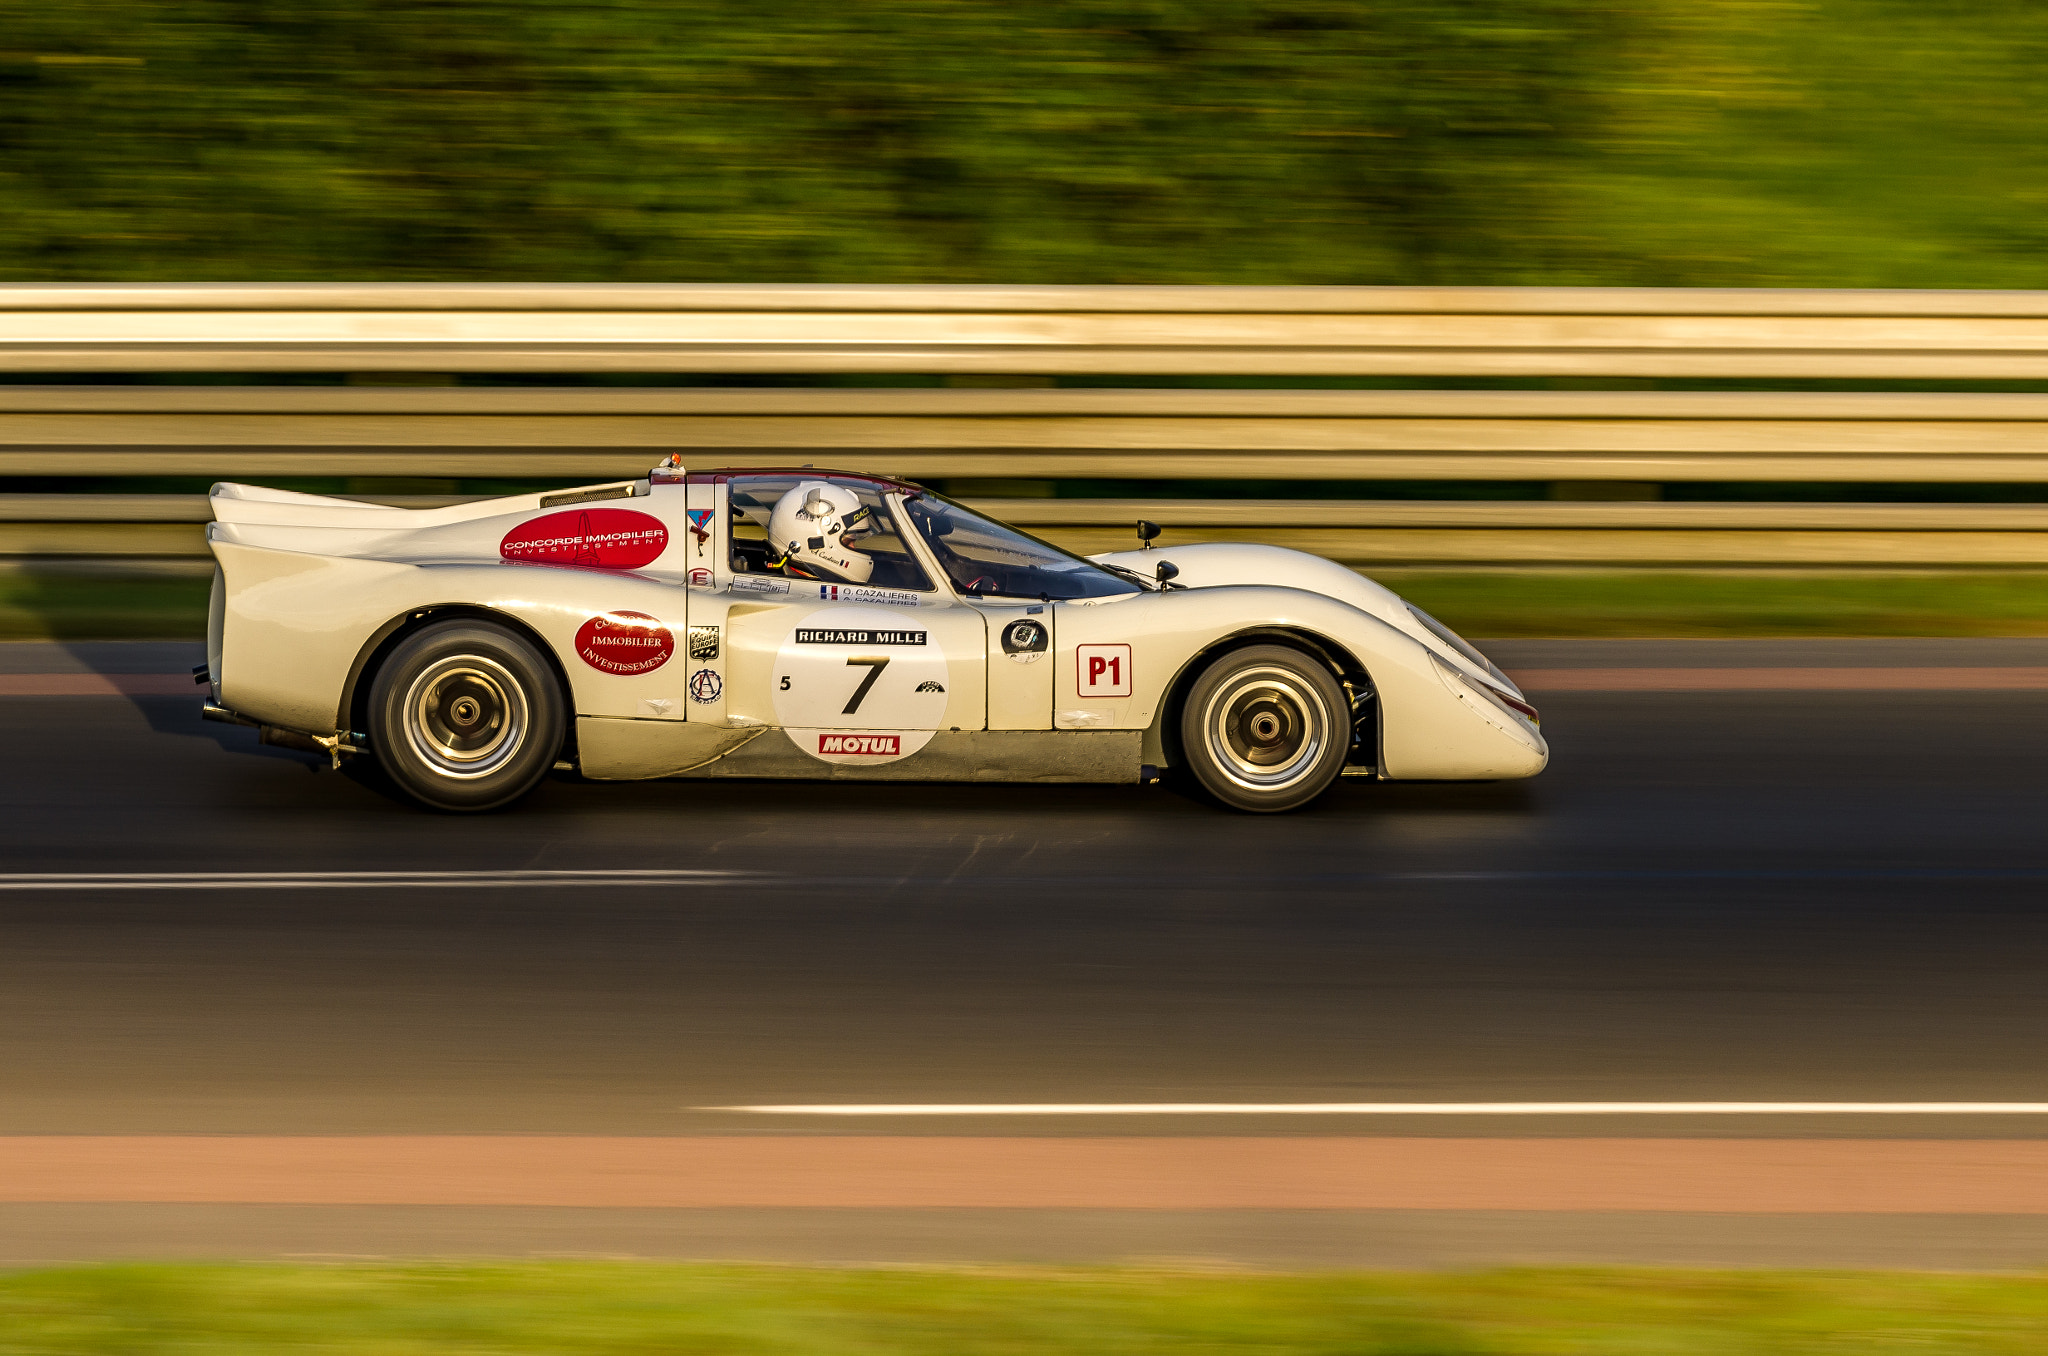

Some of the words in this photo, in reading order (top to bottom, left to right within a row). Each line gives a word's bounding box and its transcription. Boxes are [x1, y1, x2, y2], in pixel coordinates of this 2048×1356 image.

[504, 536, 583, 550] CONCORDE
[586, 529, 664, 543] IMMOBILIER
[505, 537, 664, 555] INVESTISSEMENT
[855, 589, 918, 600] CAZALIERES
[592, 636, 662, 647] IMMOBILIER
[691, 638, 718, 649] EUROPE
[799, 631, 868, 642] RICHARD
[876, 632, 924, 643] MILLE
[583, 647, 668, 672] INVESTISSEMENT
[1089, 656, 1120, 685] P1
[779, 676, 791, 690] 5
[841, 656, 890, 714] 7
[822, 737, 897, 753] MOTUL
